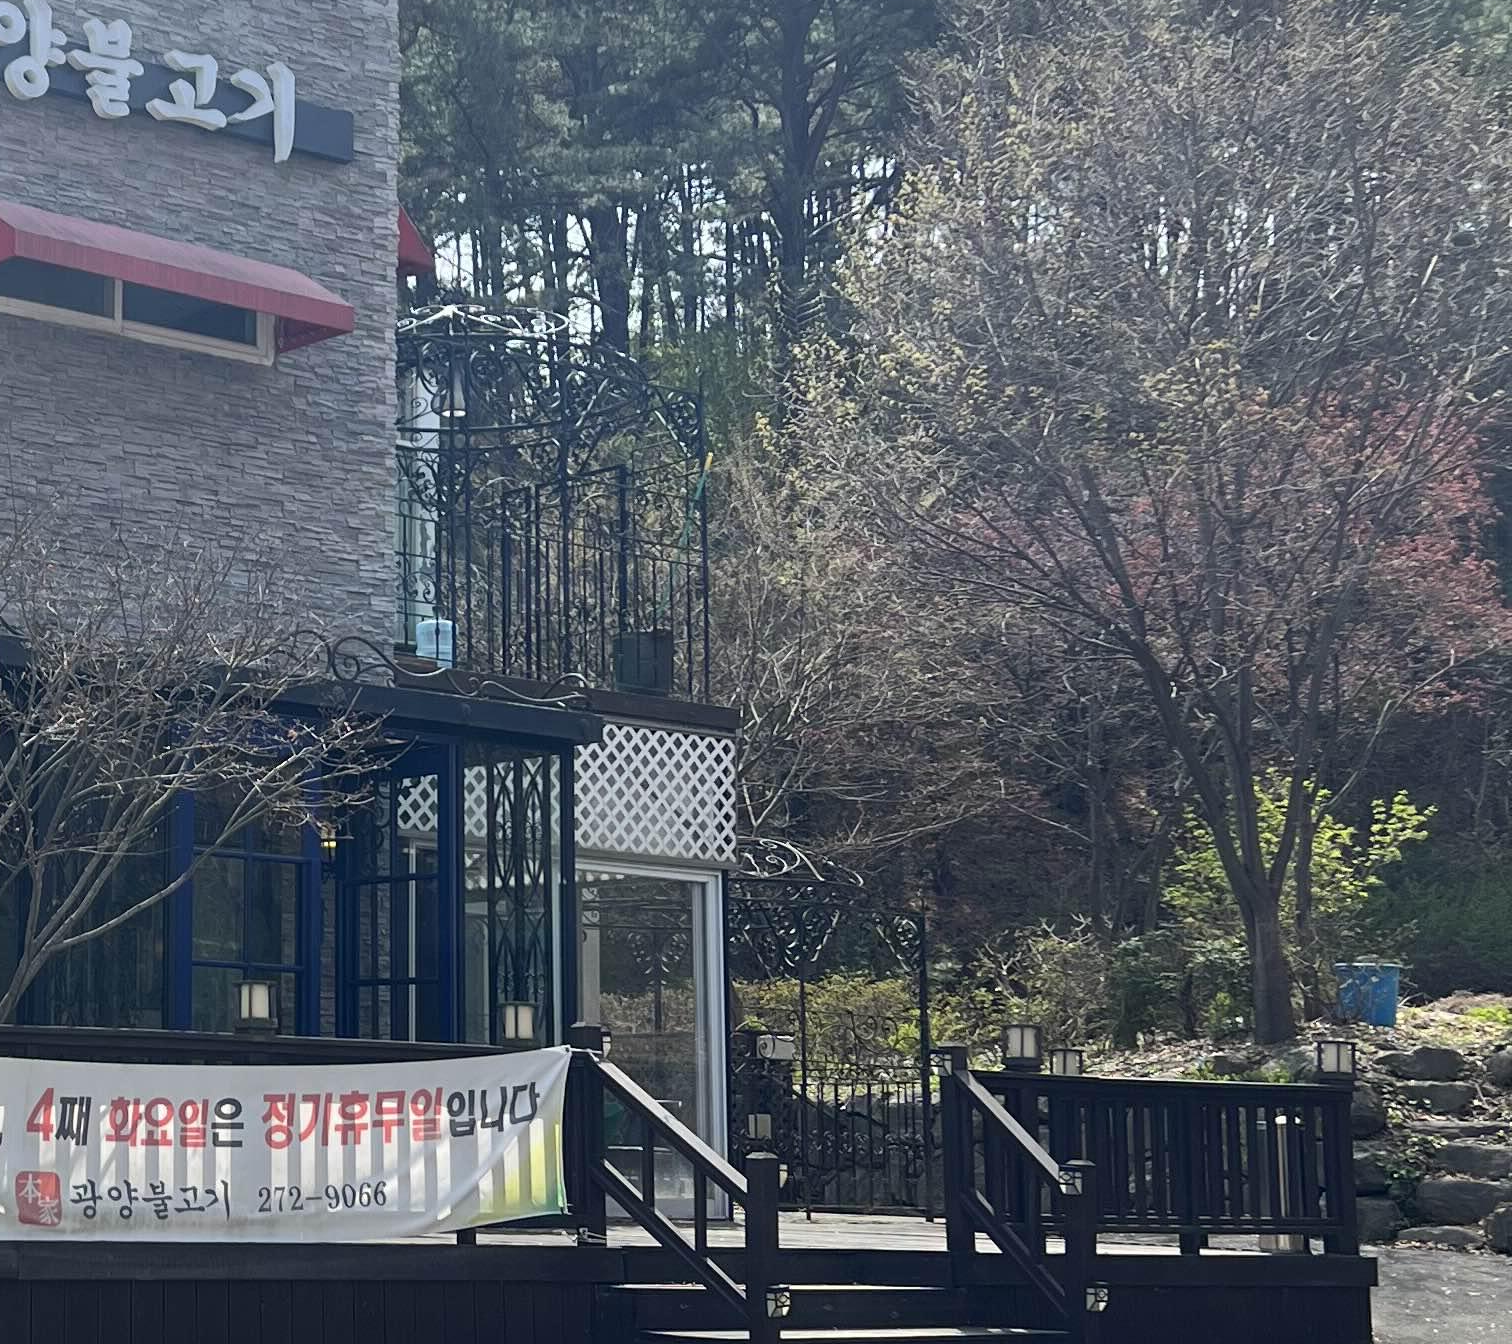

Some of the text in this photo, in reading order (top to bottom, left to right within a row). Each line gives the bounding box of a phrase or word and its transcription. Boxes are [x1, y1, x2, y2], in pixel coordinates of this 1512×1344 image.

[26, 1087, 93, 1146] 4째
[105, 1096, 245, 1150] 화요일은
[262, 1081, 541, 1150] 정기휴무일입니다
[69, 1178, 388, 1224] 광양불고기 272-9066
